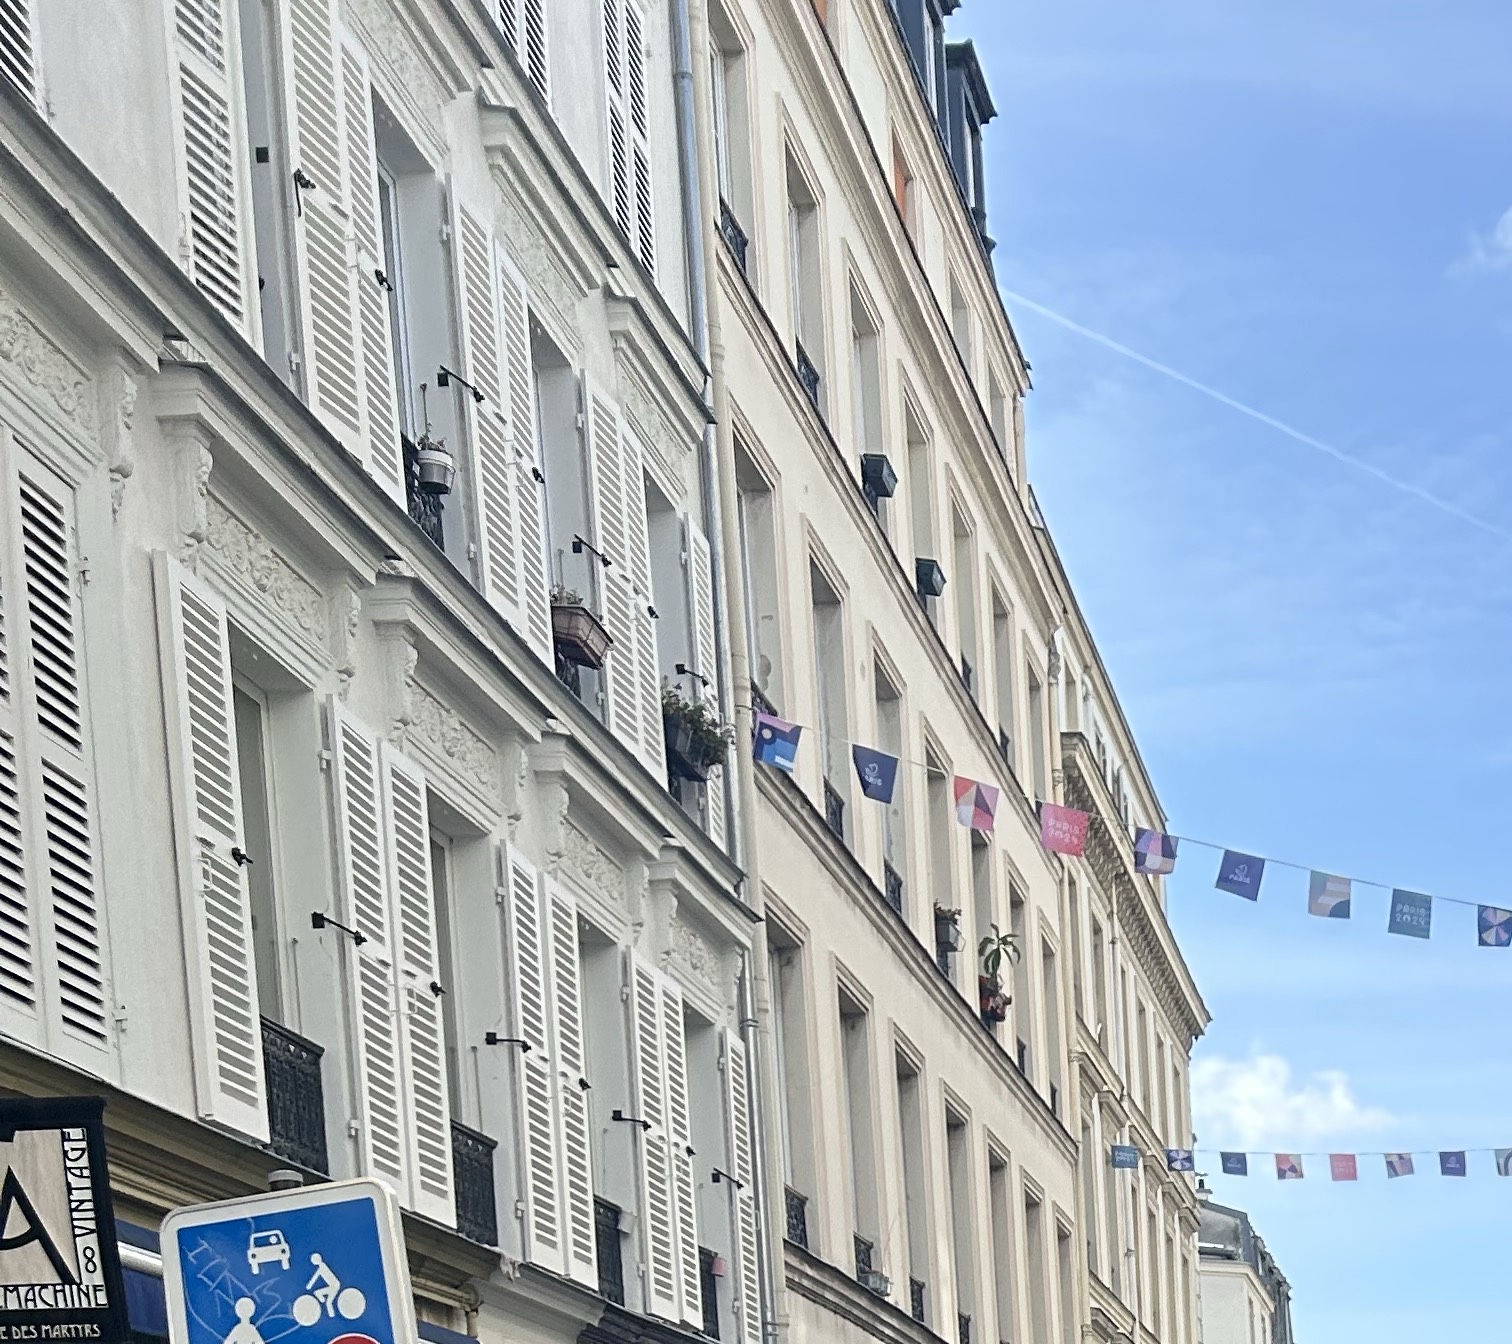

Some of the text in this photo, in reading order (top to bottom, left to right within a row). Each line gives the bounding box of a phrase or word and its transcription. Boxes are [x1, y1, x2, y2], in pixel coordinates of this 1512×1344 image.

[1396, 902, 1426, 917] PARIS
[1395, 913, 1426, 927] 2024
[62, 1127, 98, 1238] VINTAGE
[0, 1284, 108, 1309] MACHINE
[12, 1326, 38, 1340] DES
[41, 1324, 101, 1340] MARTYRS
